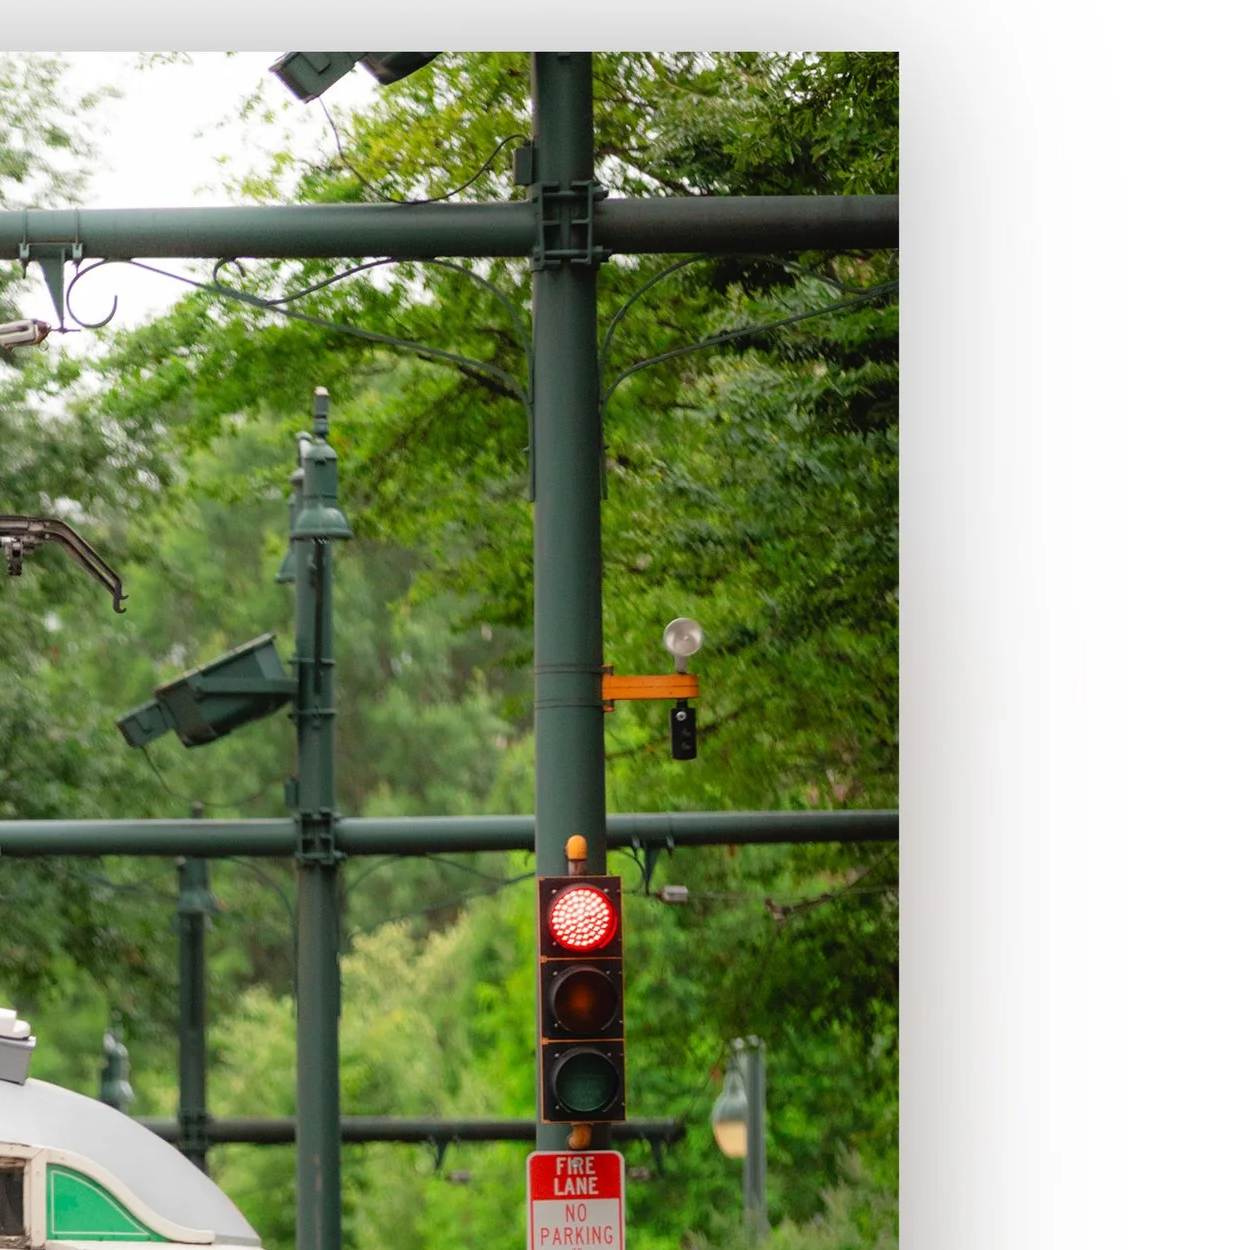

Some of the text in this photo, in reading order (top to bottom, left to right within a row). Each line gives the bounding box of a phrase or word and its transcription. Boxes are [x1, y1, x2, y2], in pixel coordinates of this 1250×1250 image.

[556, 1156, 596, 1176] FIRE
[553, 1177, 599, 1196] LANE
[565, 1203, 587, 1222] NO
[540, 1226, 613, 1246] PARKING
